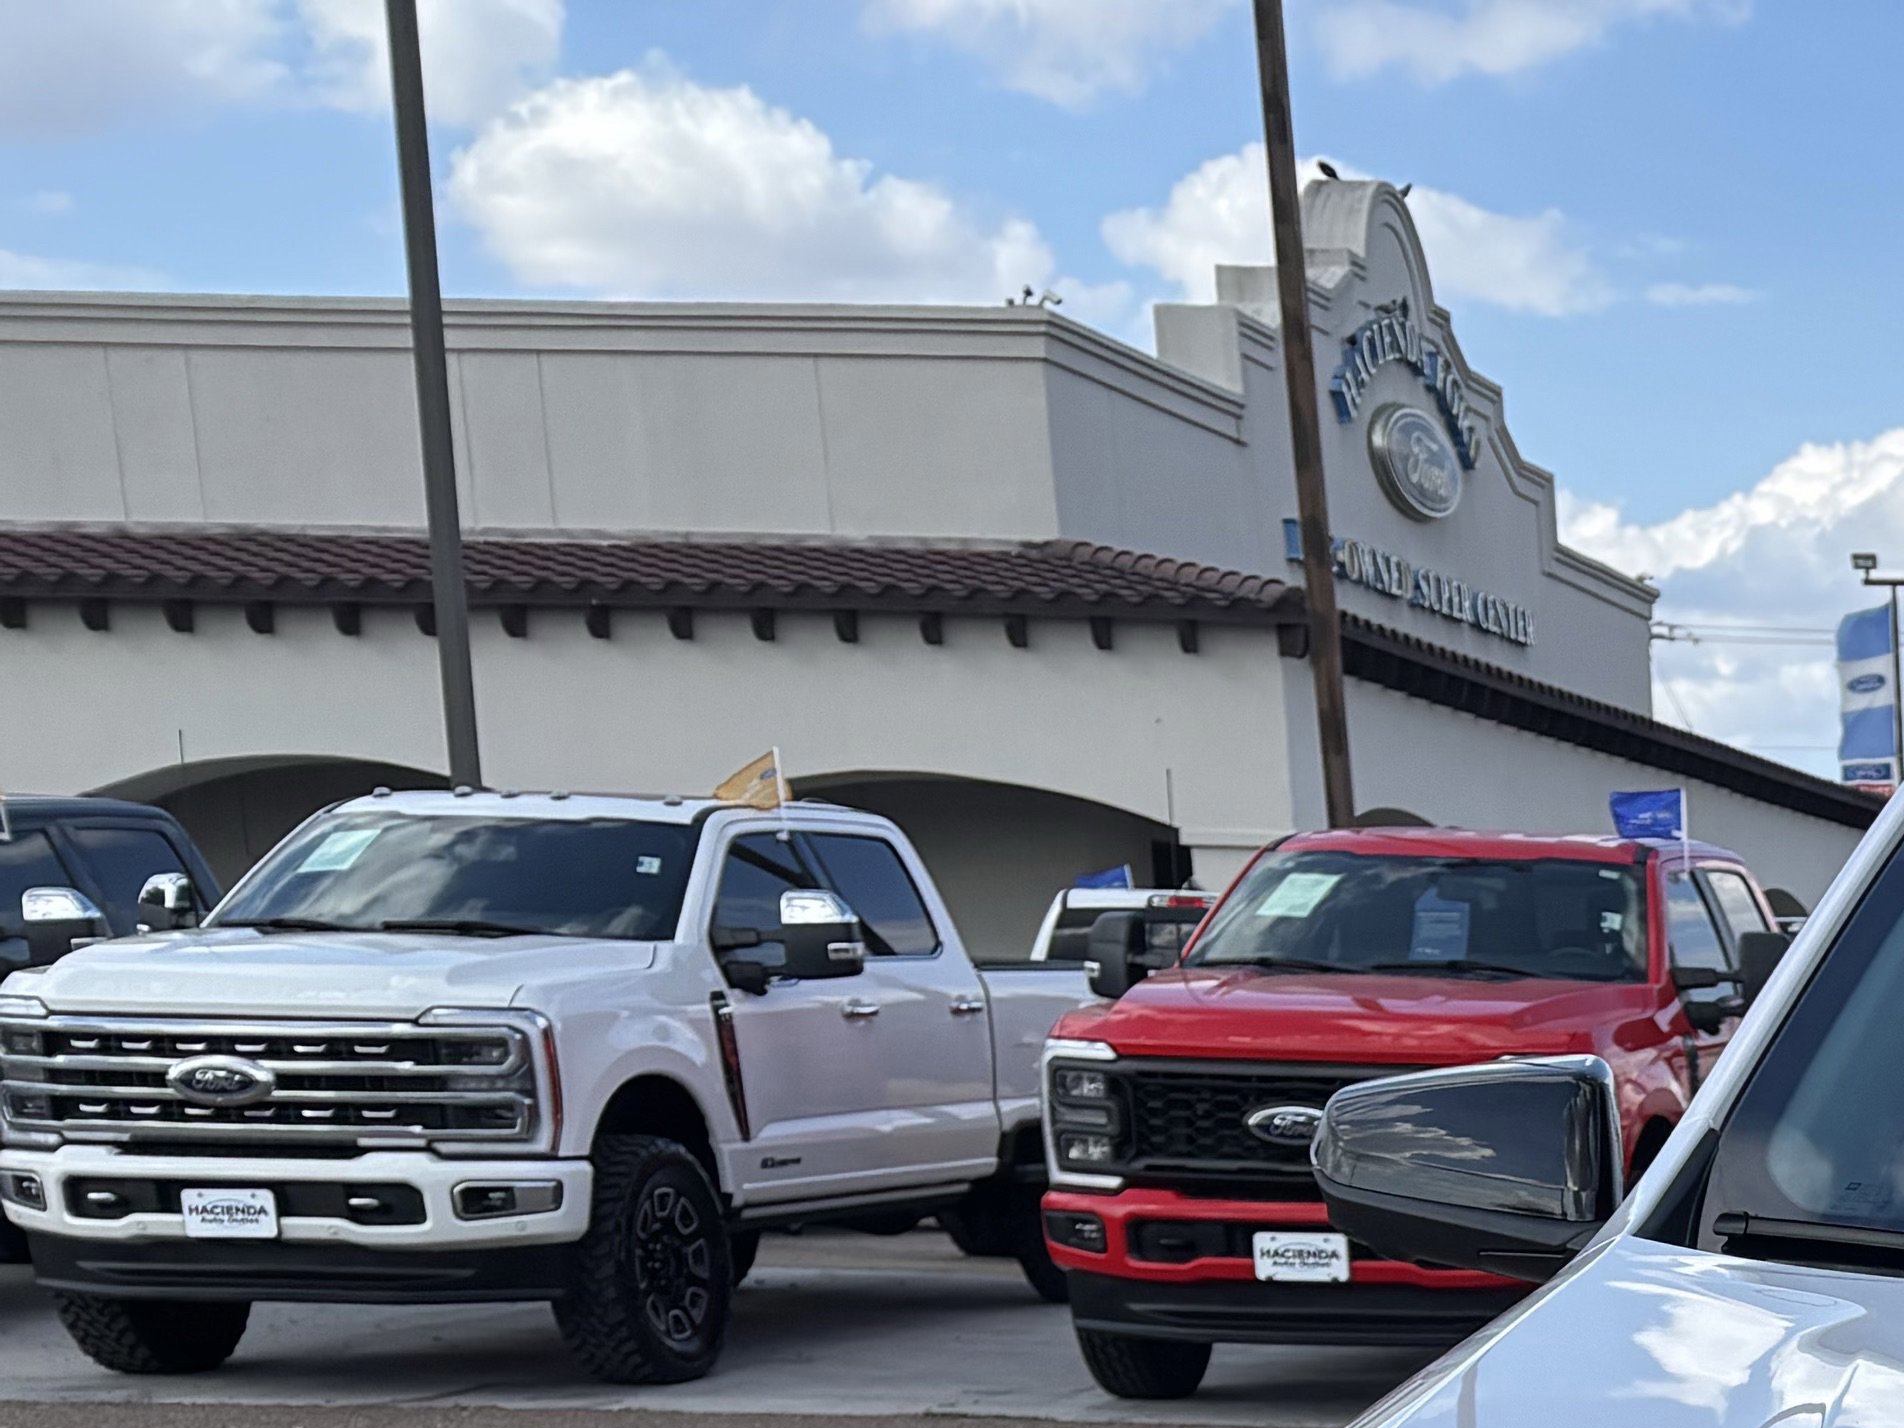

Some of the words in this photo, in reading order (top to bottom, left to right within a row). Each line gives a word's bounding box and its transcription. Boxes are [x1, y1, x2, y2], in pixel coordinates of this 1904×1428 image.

[1476, 590, 1536, 647] CENTER
[188, 1204, 269, 1217] HACIENDA
[1260, 1247, 1340, 1261] HACIENDA
